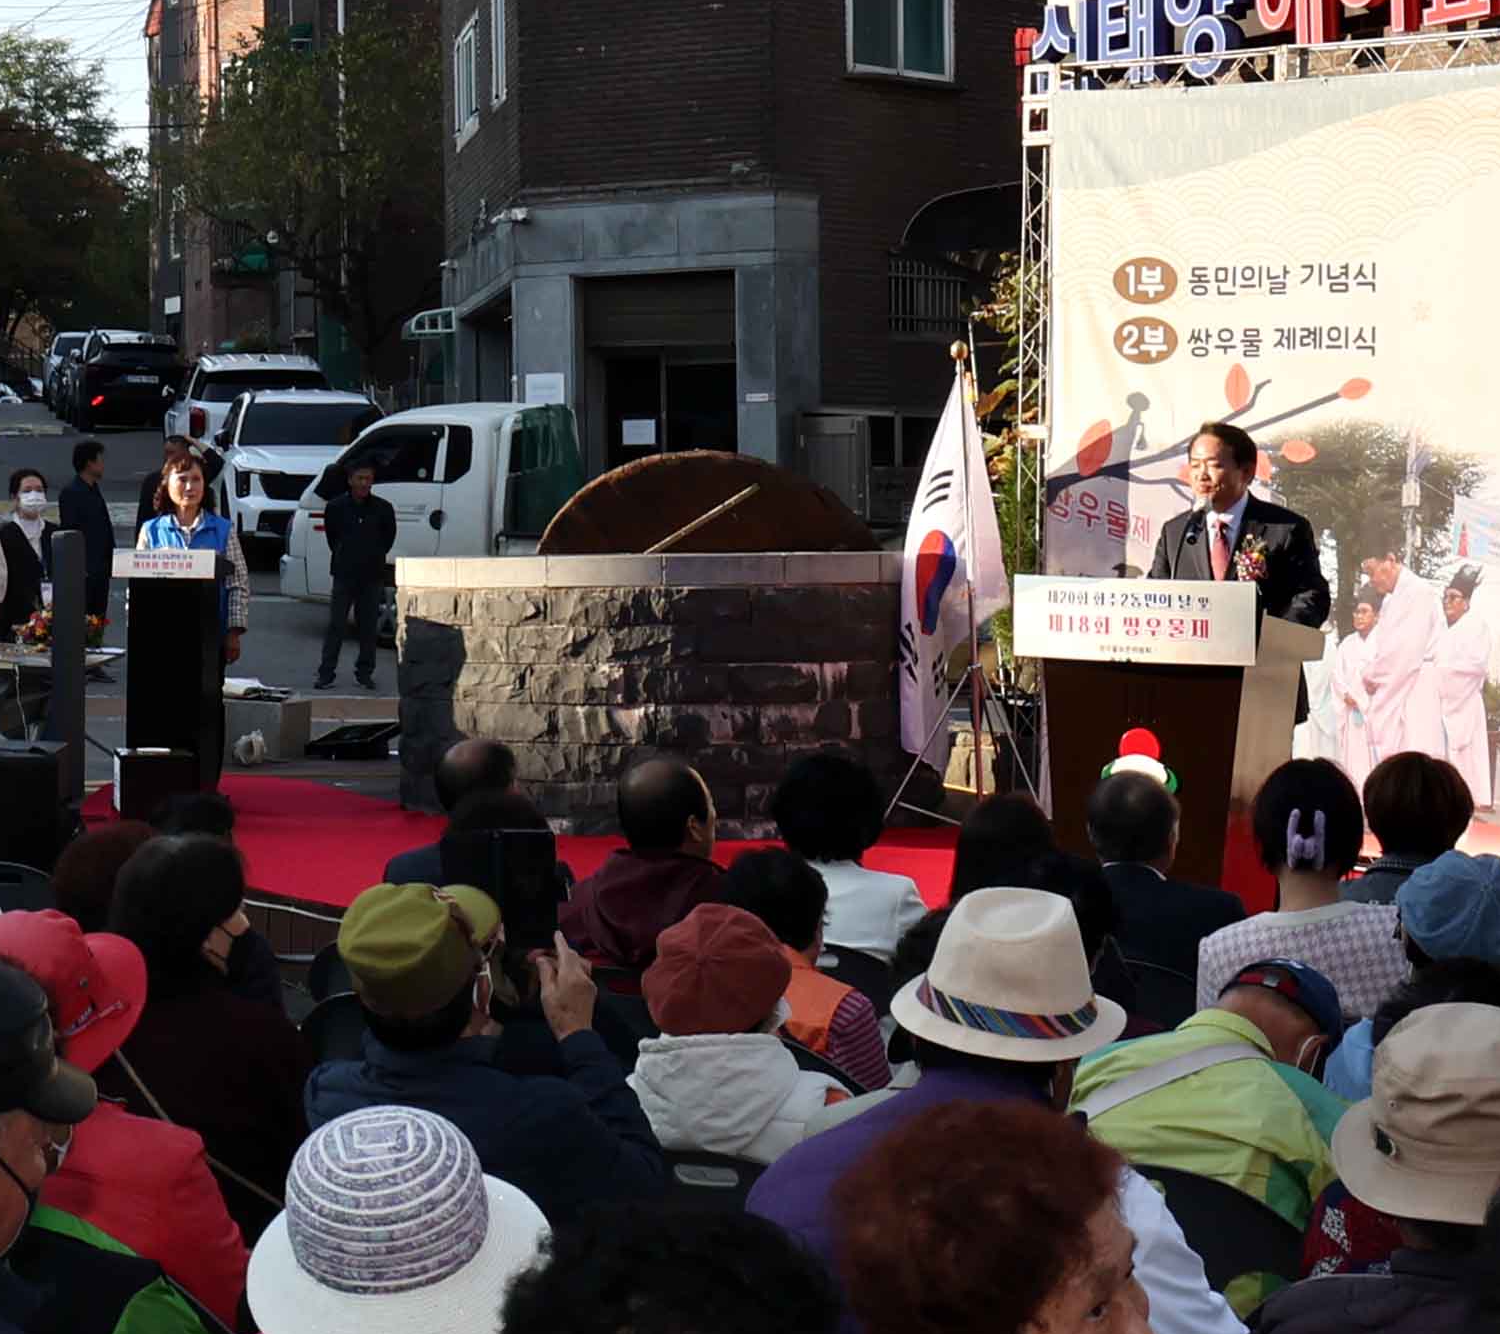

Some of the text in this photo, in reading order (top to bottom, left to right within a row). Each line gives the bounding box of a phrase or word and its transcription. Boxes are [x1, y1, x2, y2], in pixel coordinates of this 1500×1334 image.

[1124, 262, 1377, 299] 1부 동민의날 기념식
[1122, 324, 1377, 359] 2부 쌍우물 제례의식
[1048, 613, 1110, 635] 제18회
